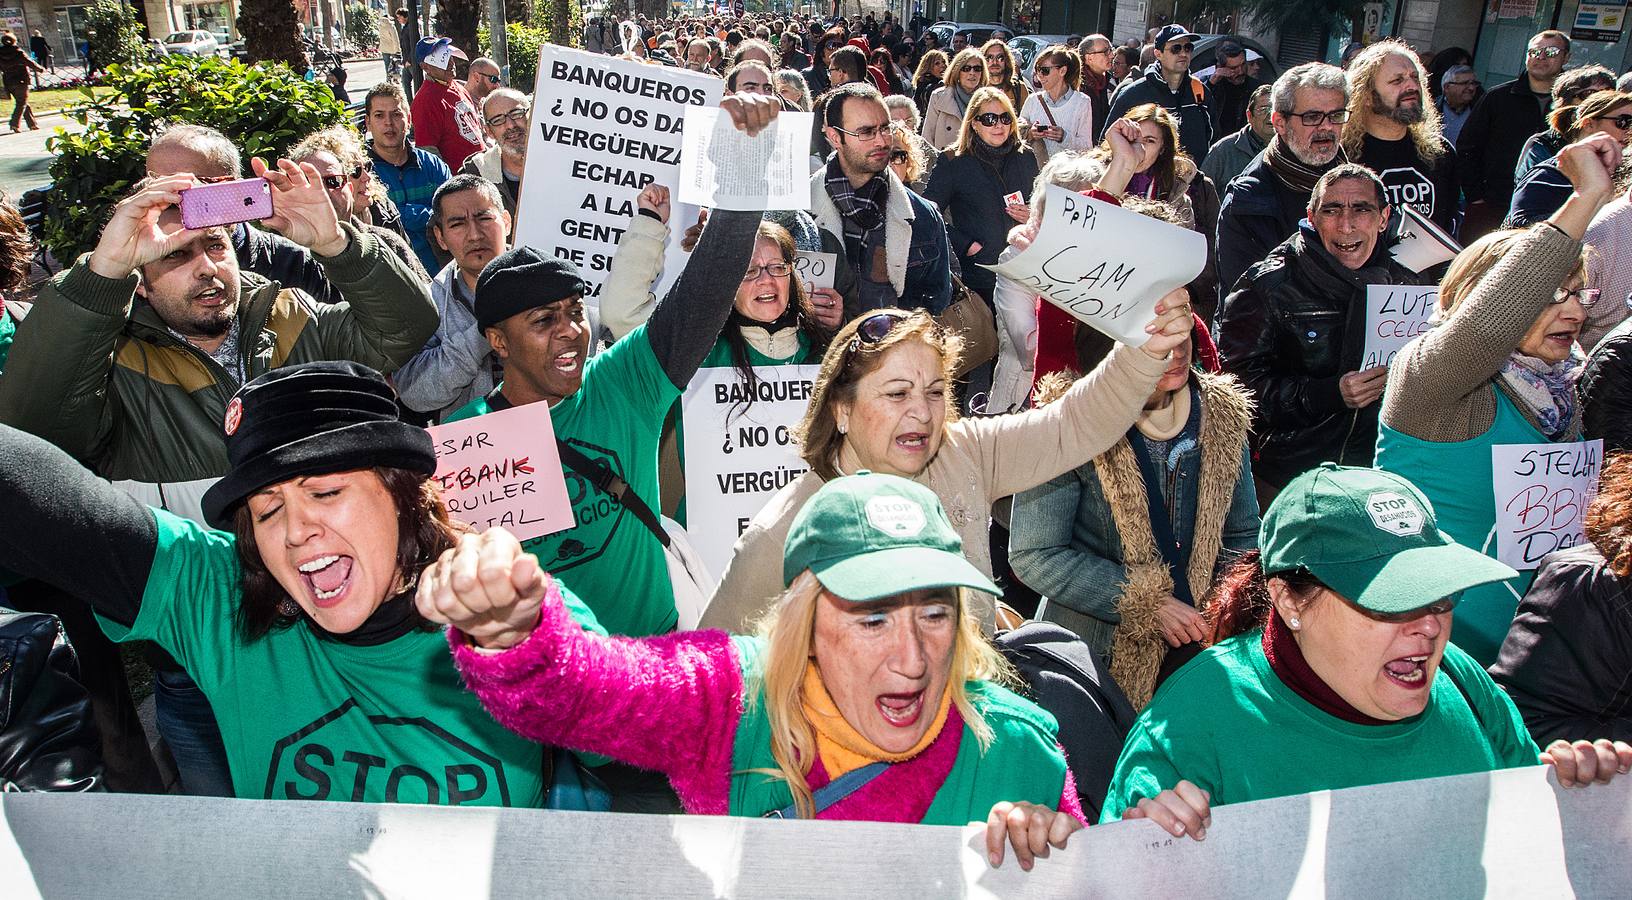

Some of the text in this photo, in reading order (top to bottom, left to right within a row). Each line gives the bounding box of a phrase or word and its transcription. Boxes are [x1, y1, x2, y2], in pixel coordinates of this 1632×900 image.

[551, 60, 706, 106] BANQUEROS
[551, 97, 684, 136] ¿ NO OS DA
[571, 160, 655, 190] ECHAR
[580, 193, 634, 217] A LA
[554, 246, 586, 268] DE
[1042, 245, 1136, 292] CAM
[739, 426, 769, 448] NO
[1513, 447, 1596, 478] STELLA
[716, 465, 808, 495] VERGÜE
[1372, 498, 1407, 513] STOP
[284, 743, 488, 807] STOP
